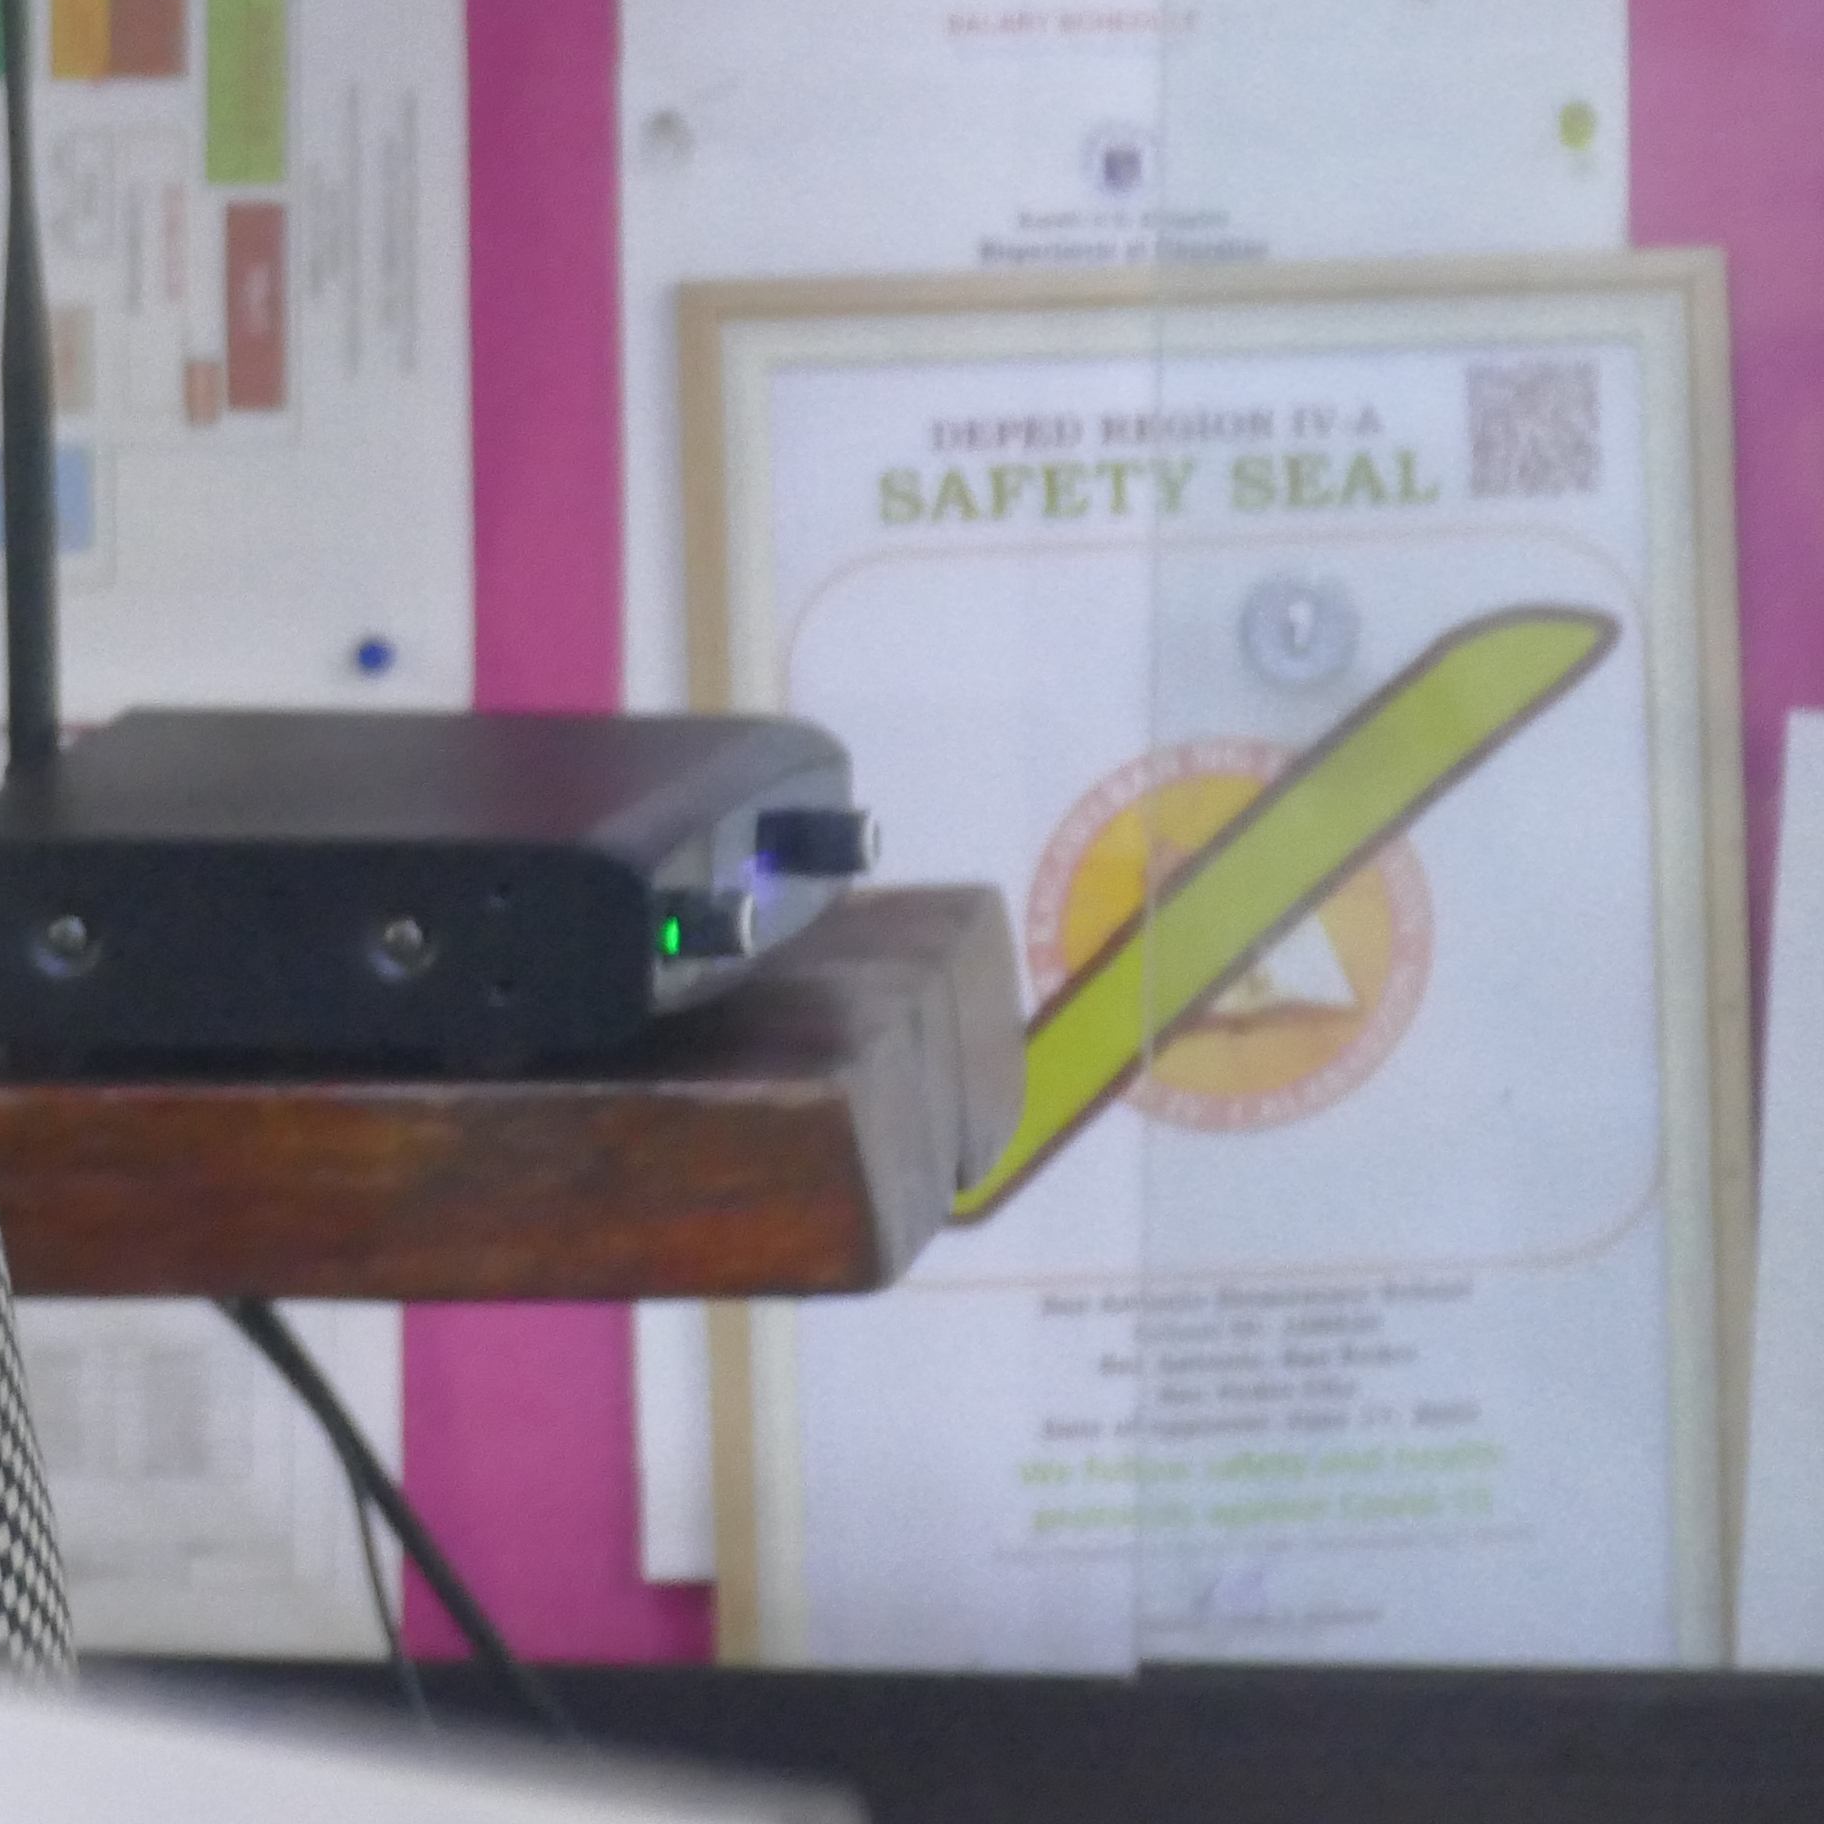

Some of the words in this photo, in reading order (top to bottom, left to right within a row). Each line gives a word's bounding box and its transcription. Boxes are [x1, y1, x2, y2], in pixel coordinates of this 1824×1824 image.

[932, 412, 1082, 453] DEPED
[1100, 407, 1273, 447] REGION
[877, 456, 1196, 525] SAFETY
[1230, 448, 1440, 512] SEAL
